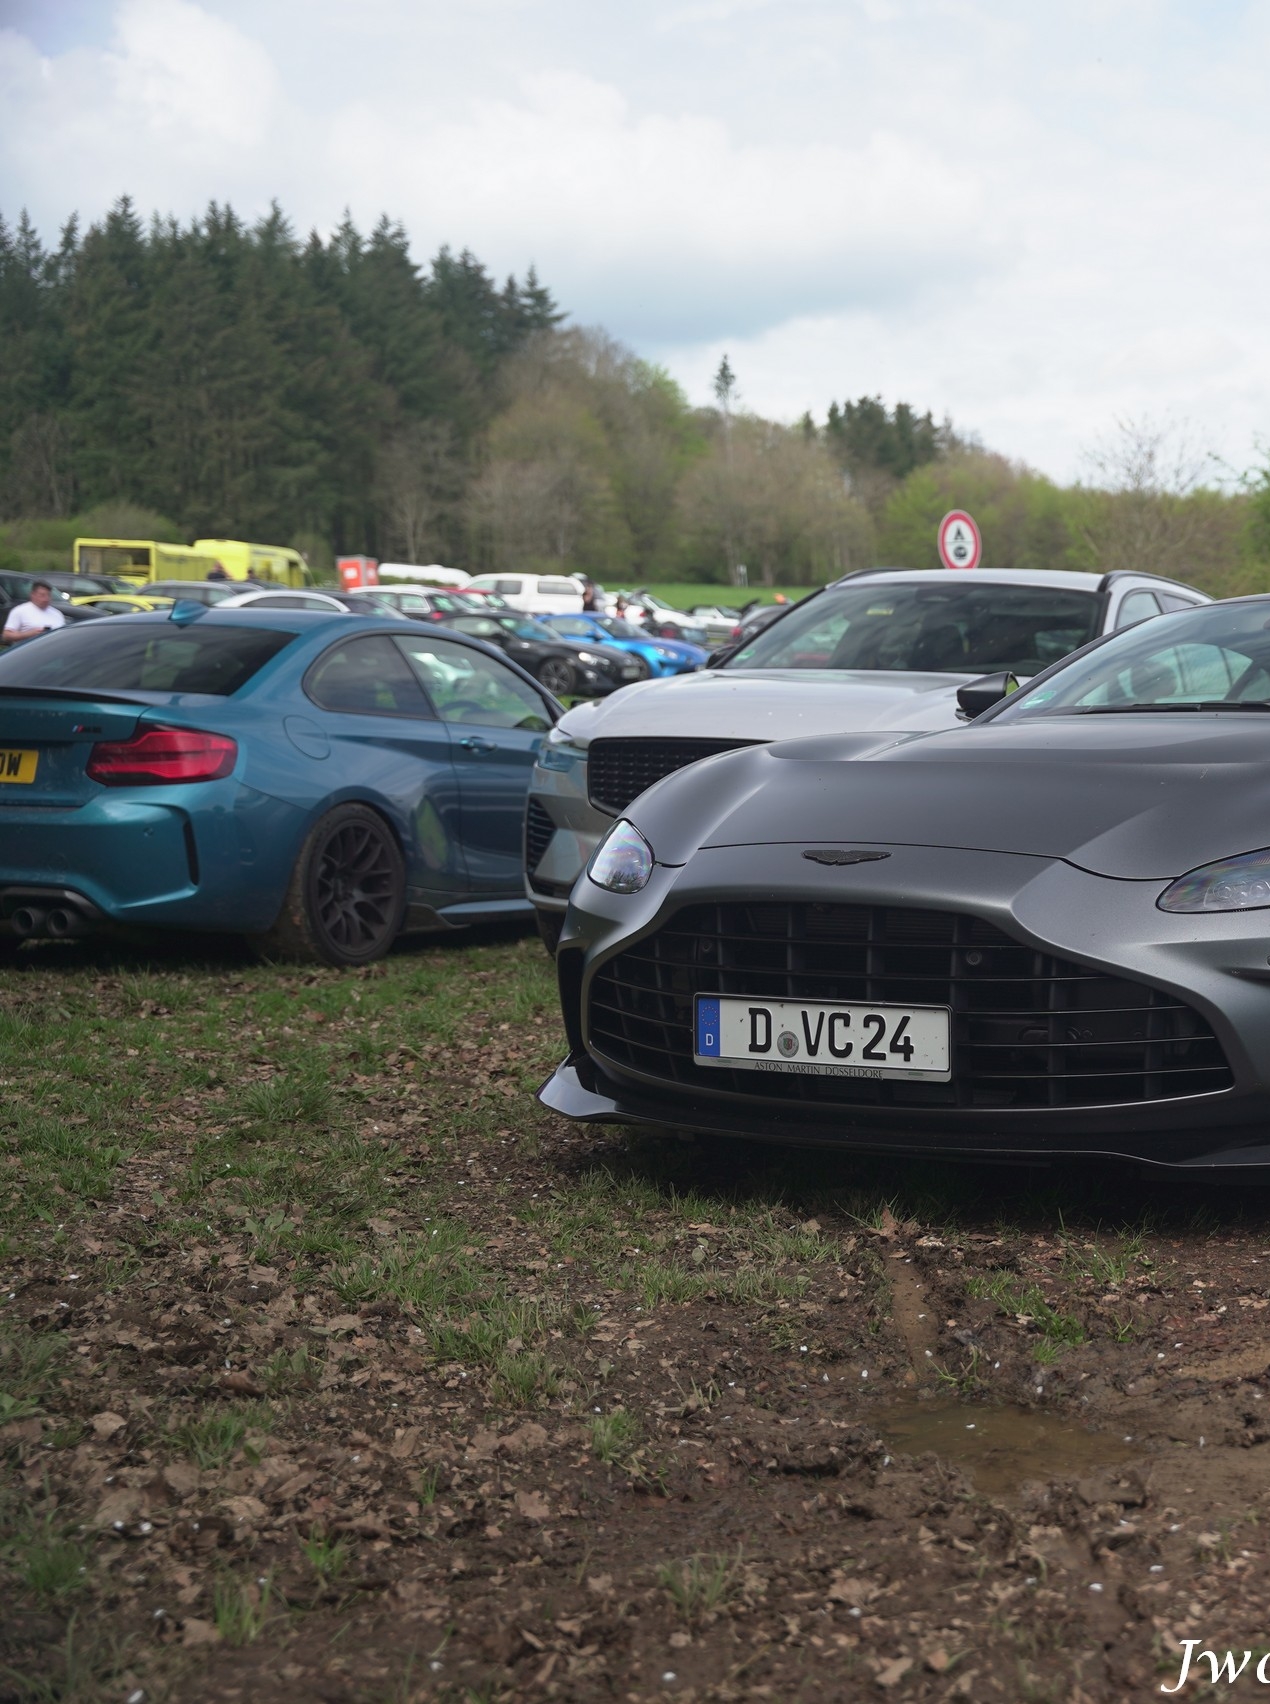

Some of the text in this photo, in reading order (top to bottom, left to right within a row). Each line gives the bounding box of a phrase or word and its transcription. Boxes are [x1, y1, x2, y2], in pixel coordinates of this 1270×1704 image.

[748, 1007, 772, 1053] D
[705, 1033, 714, 1046] D
[754, 1062, 782, 1071] ASTON
[787, 1064, 820, 1074] MARTIN
